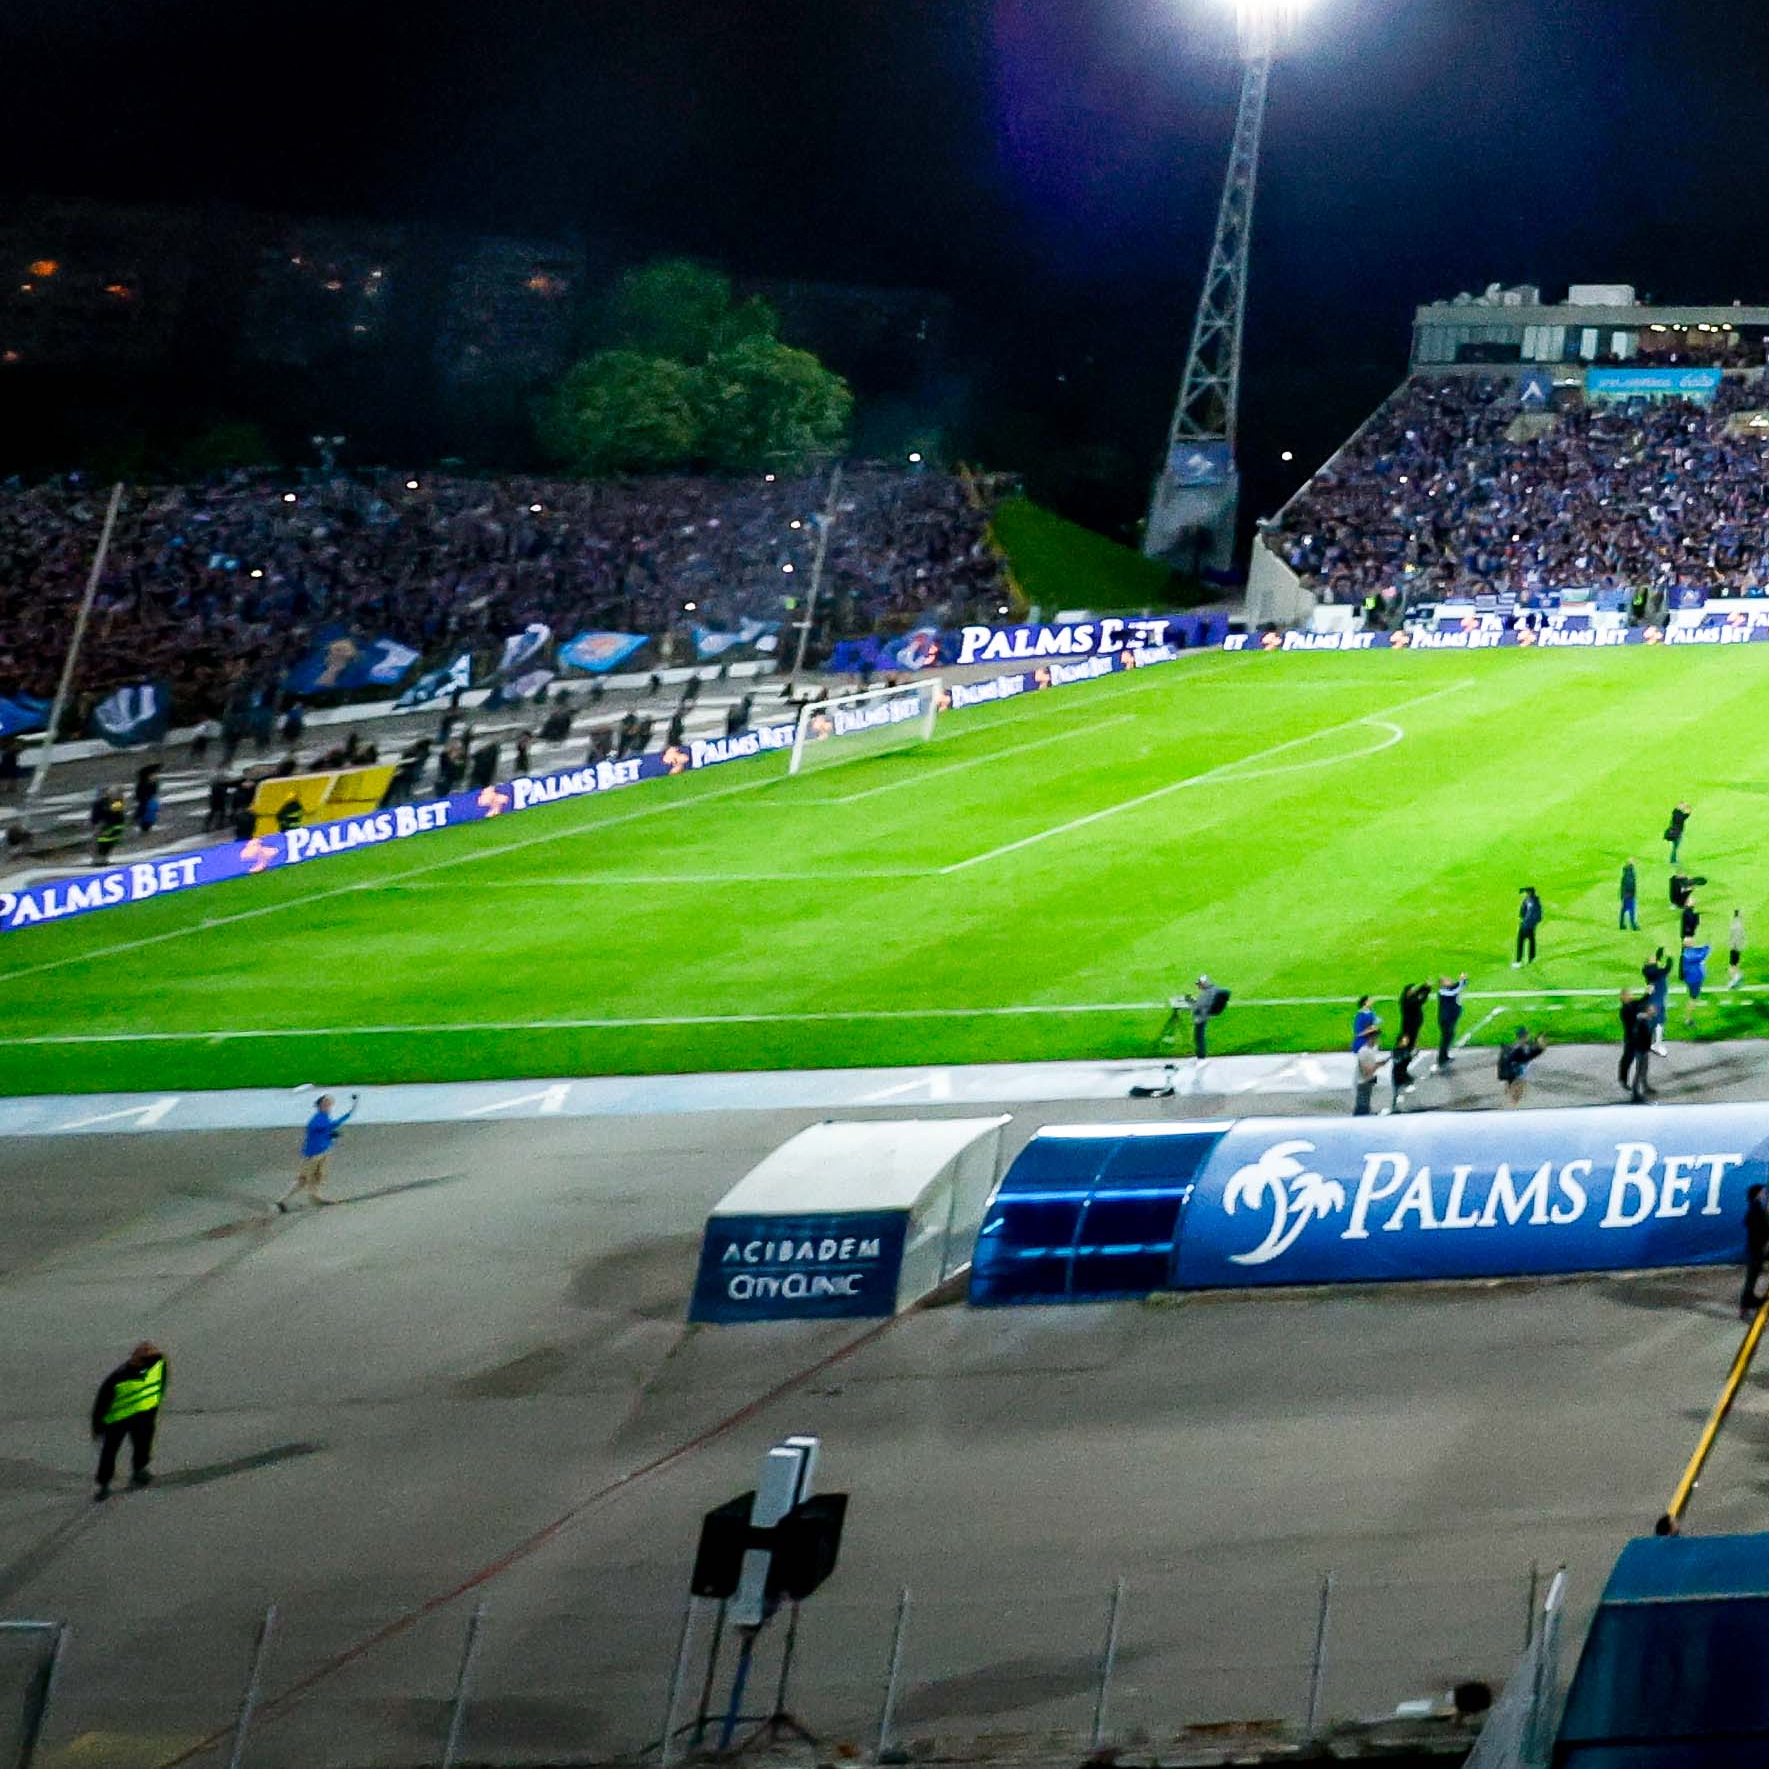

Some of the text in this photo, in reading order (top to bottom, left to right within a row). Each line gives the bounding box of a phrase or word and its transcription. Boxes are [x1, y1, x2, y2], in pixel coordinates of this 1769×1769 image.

[957, 626, 1094, 664] PALMS
[691, 723, 797, 769] PALMS BET
[513, 757, 643, 811] PALMS BET
[285, 800, 452, 864] PALMS BET
[131, 855, 203, 900] BET
[1341, 1140, 1743, 1240] PALMS BET
[722, 1237, 881, 1263] ACIBADEM
